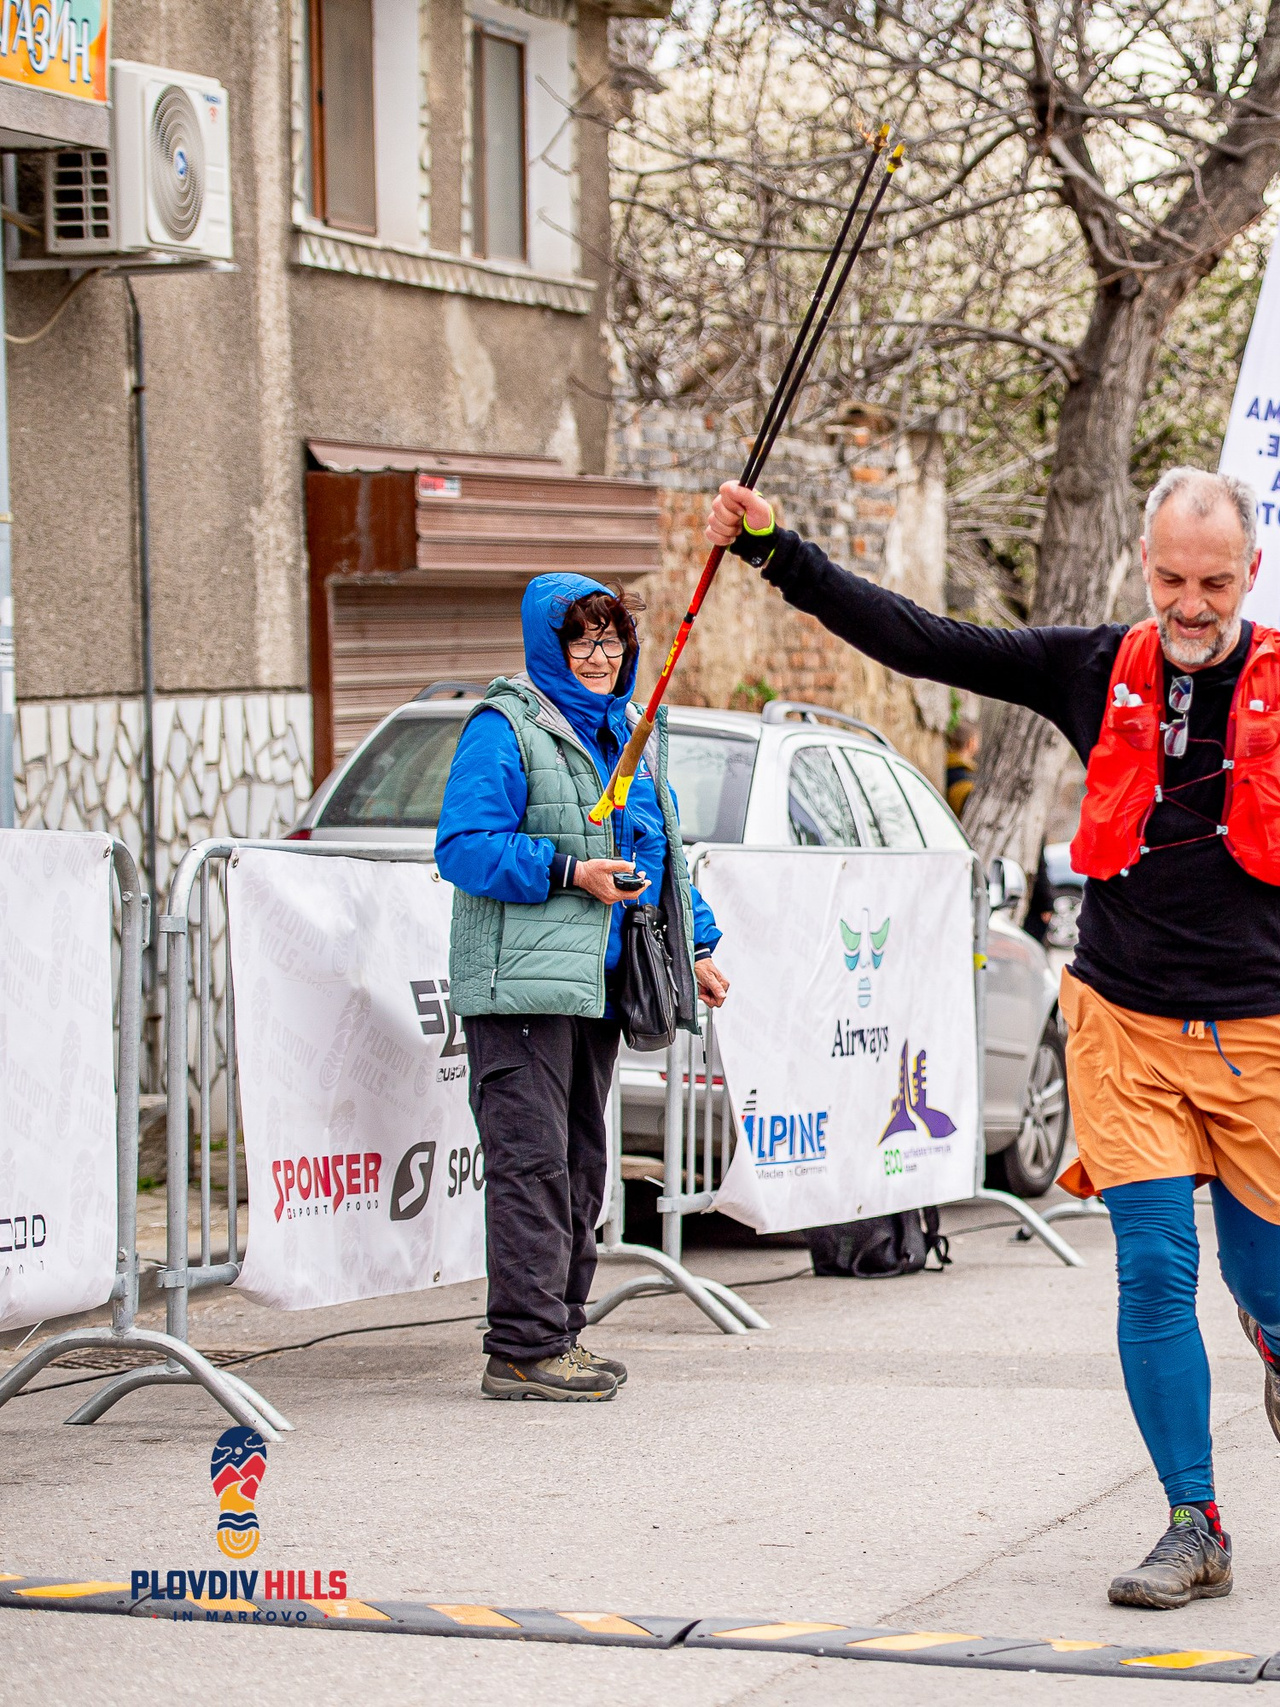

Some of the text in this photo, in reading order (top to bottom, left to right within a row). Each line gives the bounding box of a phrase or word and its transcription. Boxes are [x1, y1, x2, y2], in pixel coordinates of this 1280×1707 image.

[0, 0, 91, 83] ГАЗИН
[831, 1018, 889, 1063] Airways
[272, 1152, 382, 1224] SPONSER
[447, 1142, 486, 1198] SPO
[292, 1199, 379, 1218] SPORT FOOD
